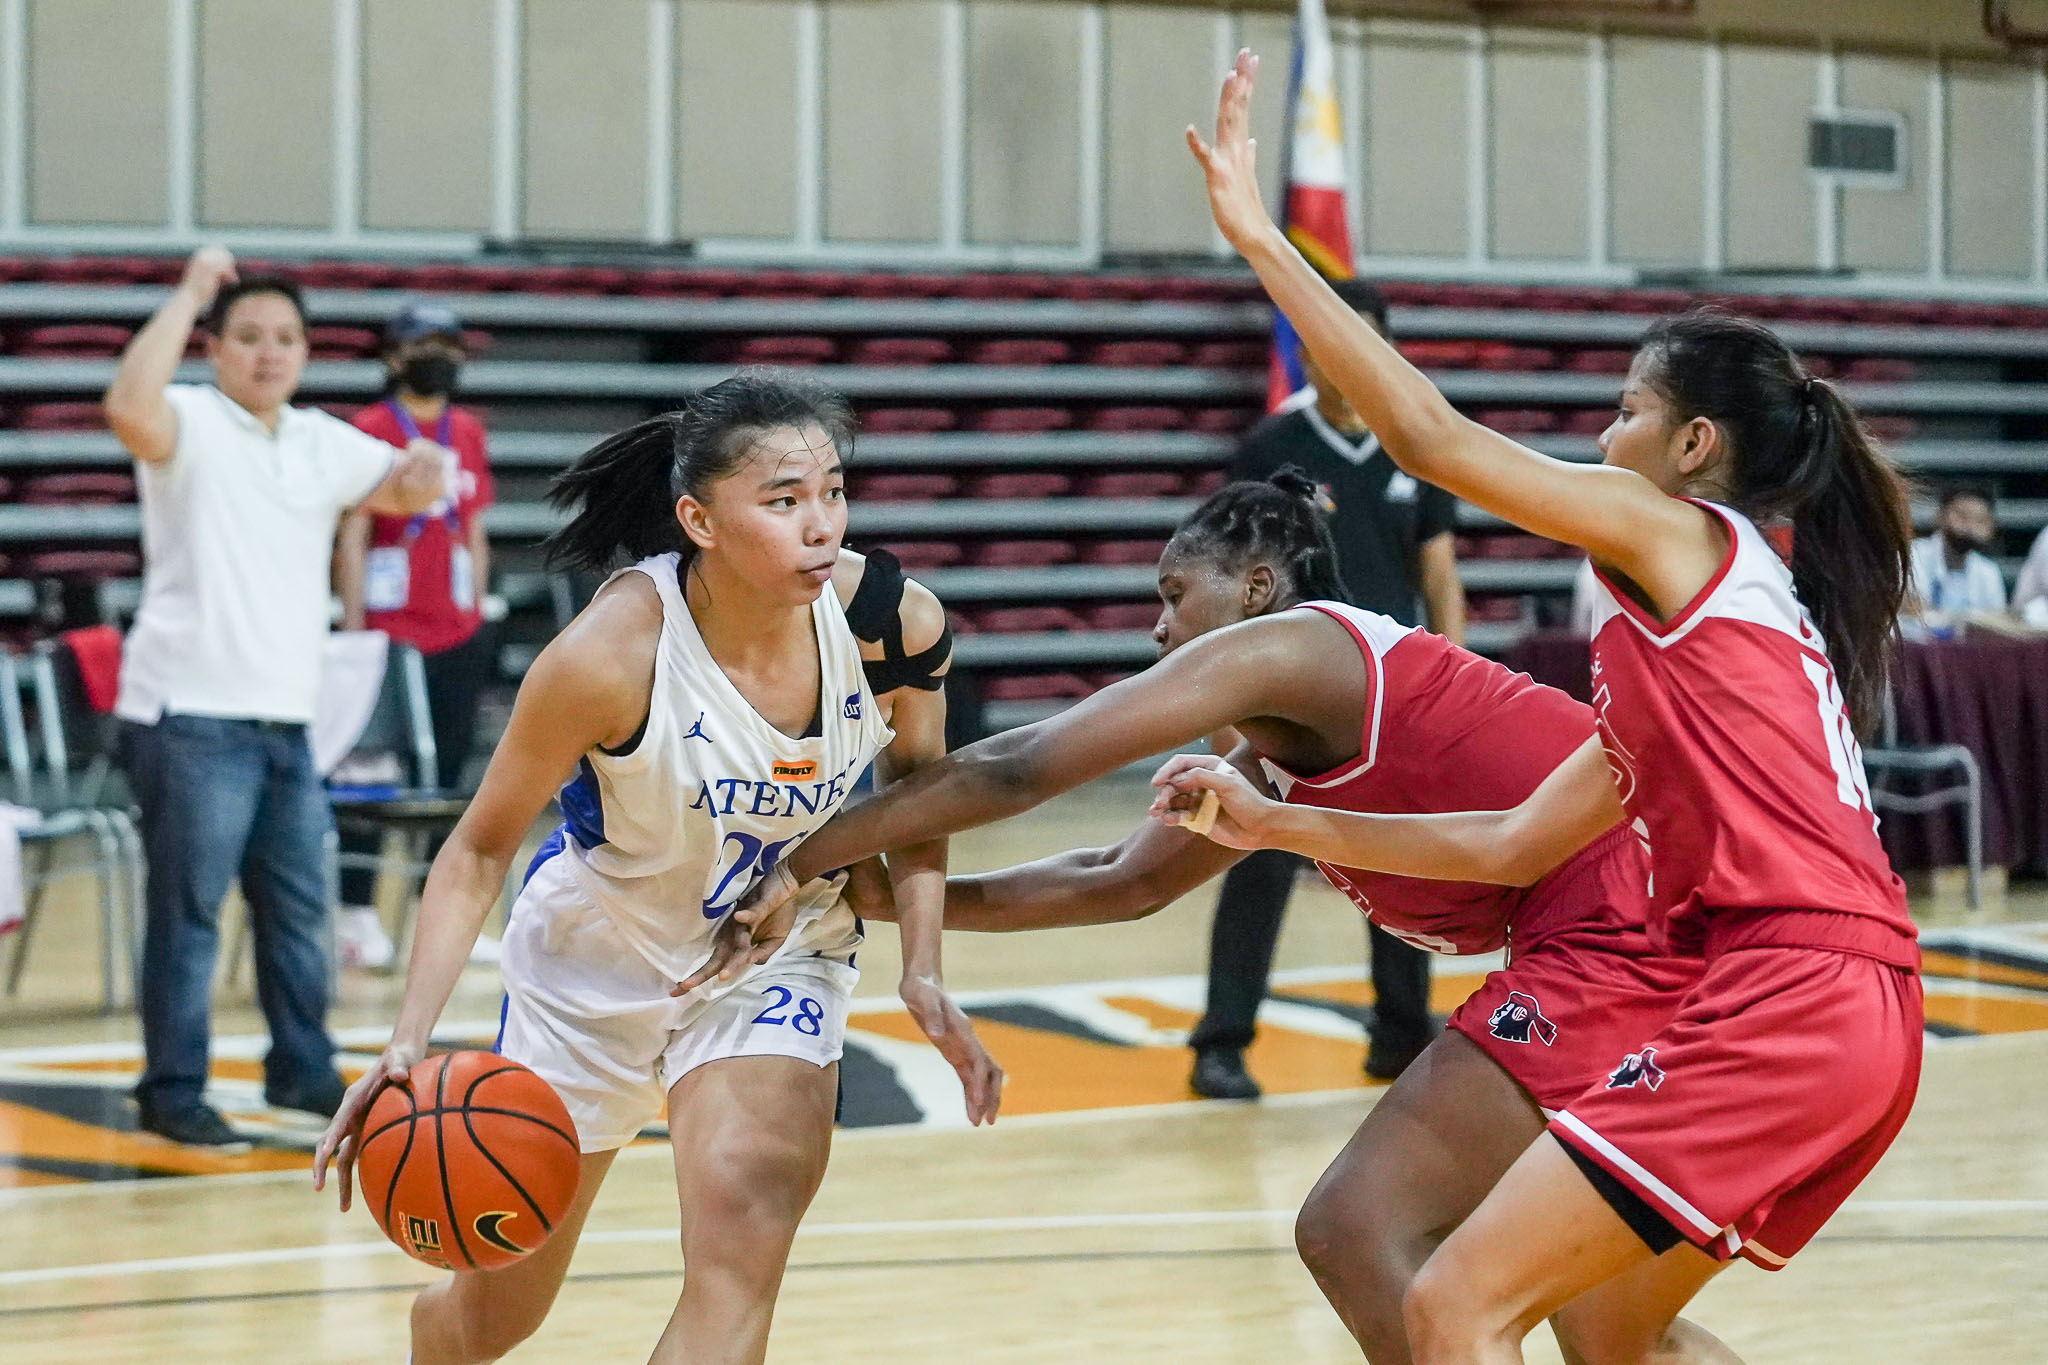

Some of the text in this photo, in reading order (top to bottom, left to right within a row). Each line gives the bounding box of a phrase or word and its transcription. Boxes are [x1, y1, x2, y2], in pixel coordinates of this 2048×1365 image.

[689, 757, 857, 818] ATENE
[774, 766, 814, 775] FIREFLY
[751, 985, 824, 1036] 28
